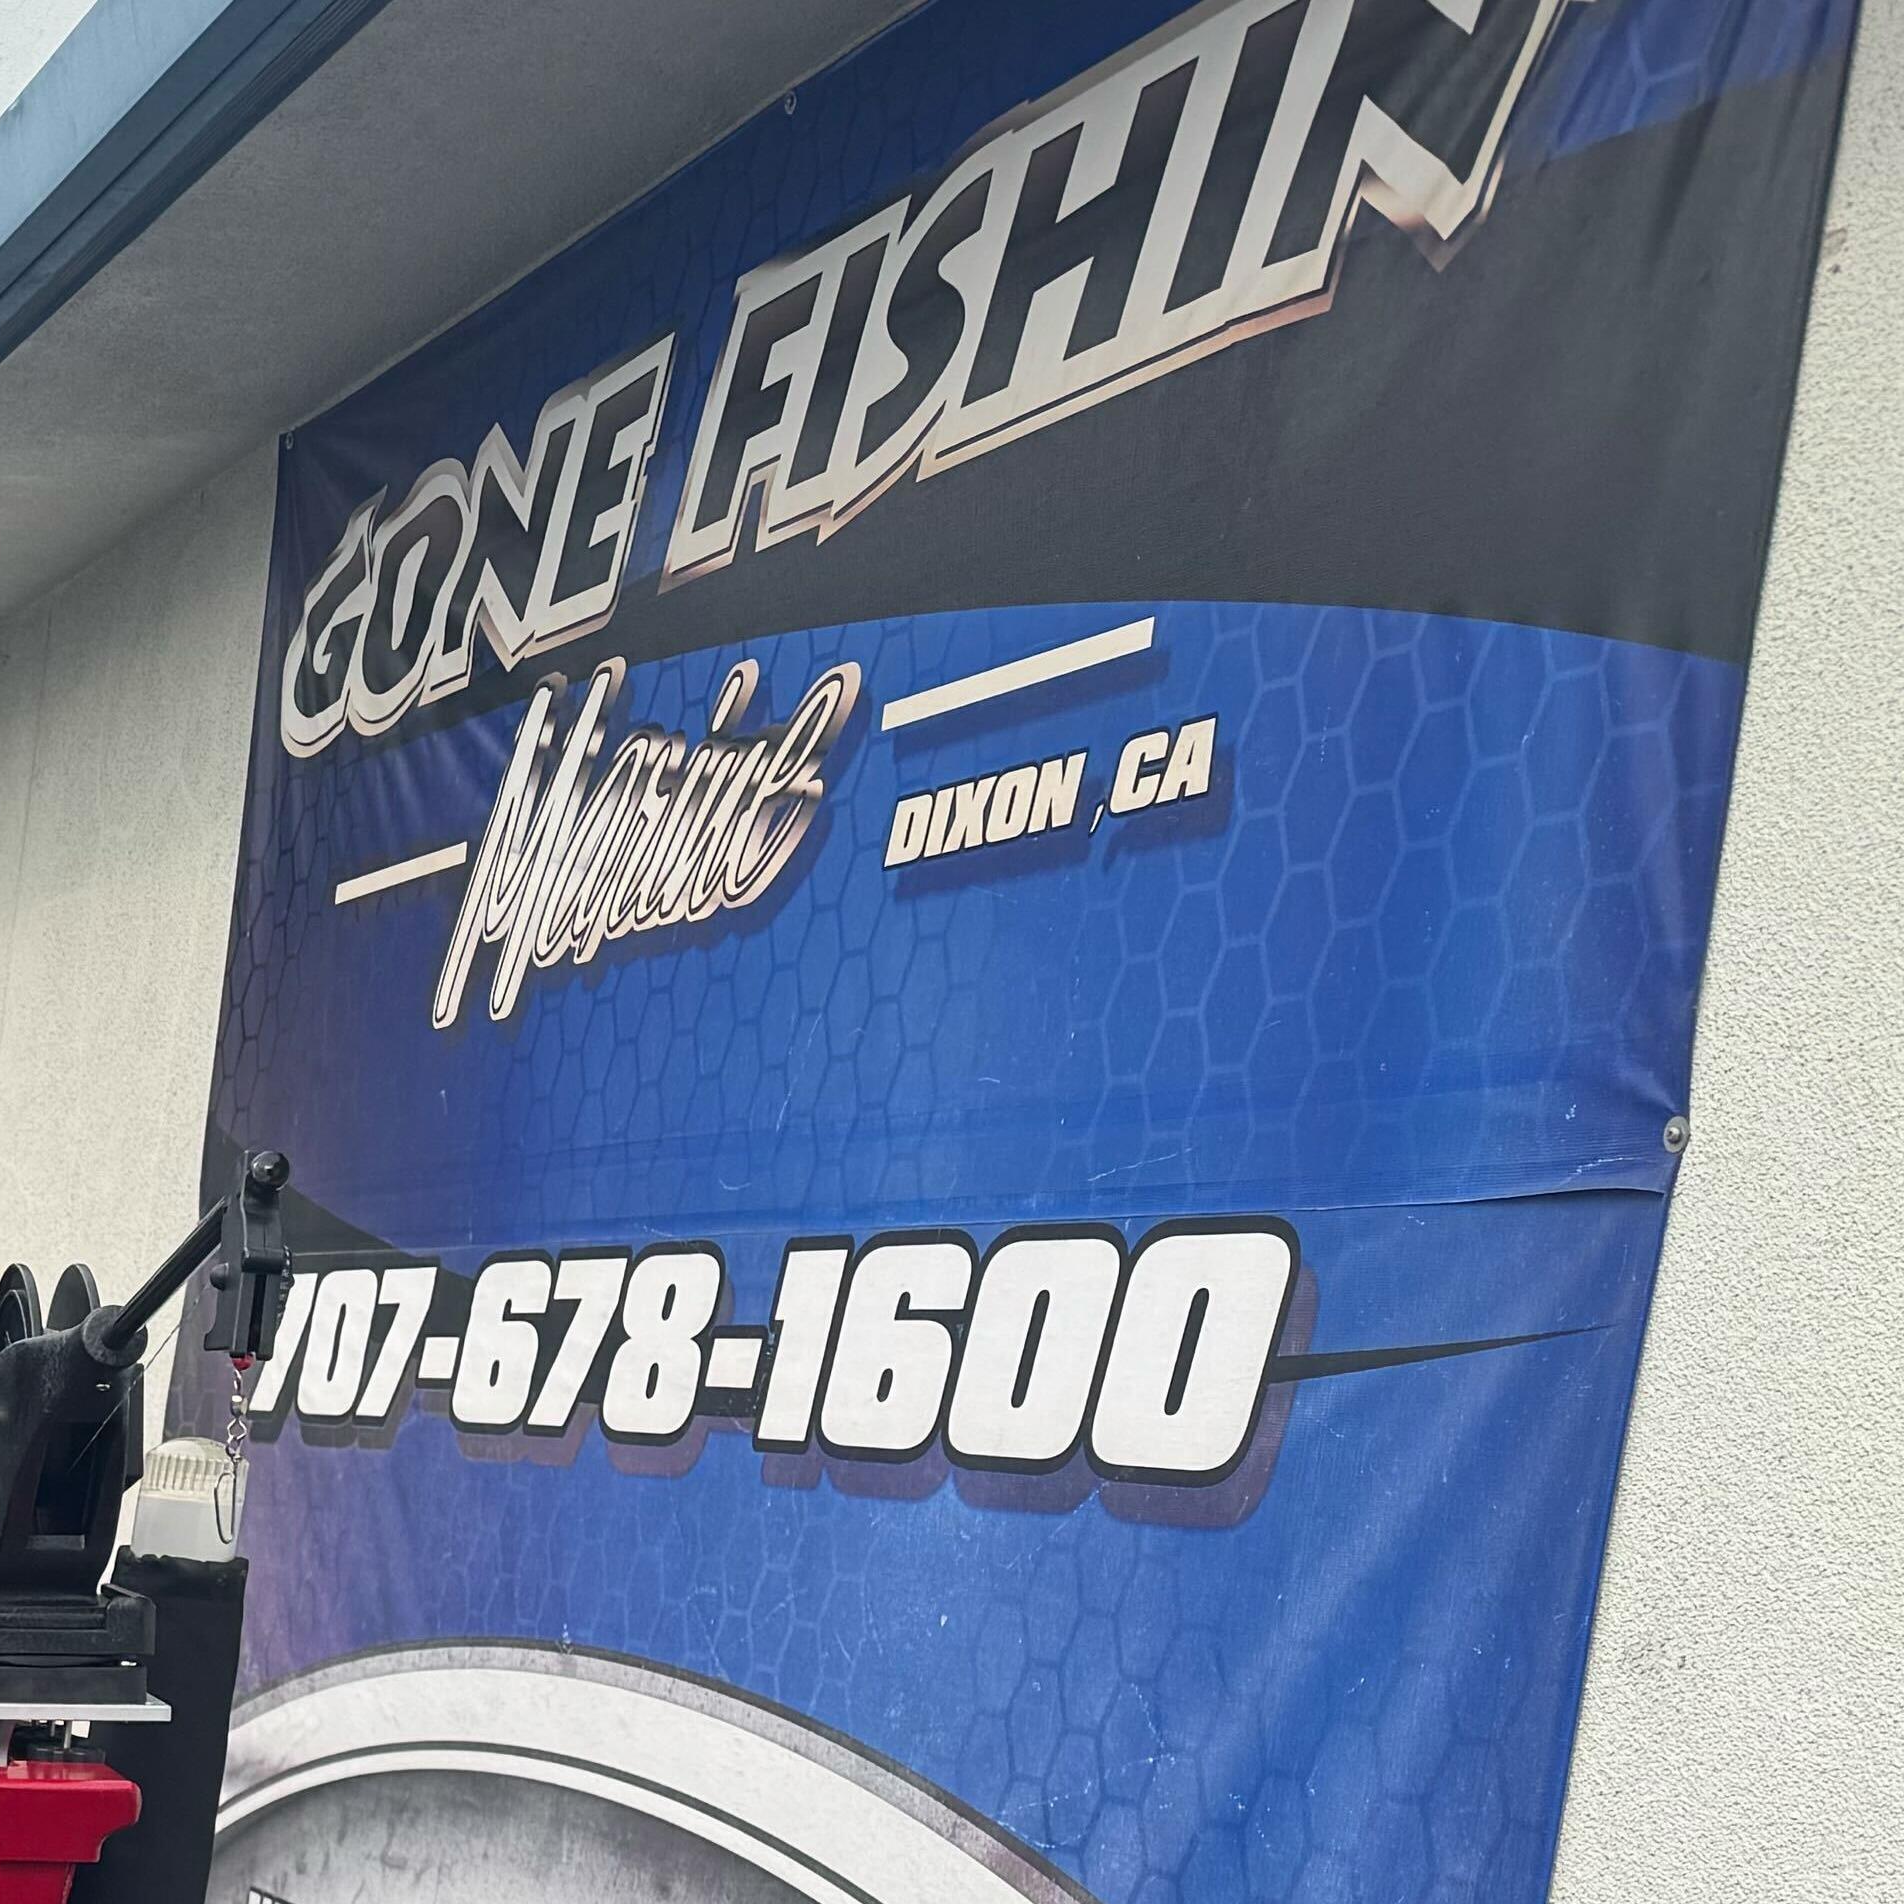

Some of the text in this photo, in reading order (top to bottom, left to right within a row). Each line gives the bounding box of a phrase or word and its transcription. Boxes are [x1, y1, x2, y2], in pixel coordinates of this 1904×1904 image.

[282, 332, 678, 757] GONE
[433, 657, 862, 1029] Marine
[883, 749, 1089, 869] DIXON
[248, 1229, 1295, 1472] 707-678-1600
